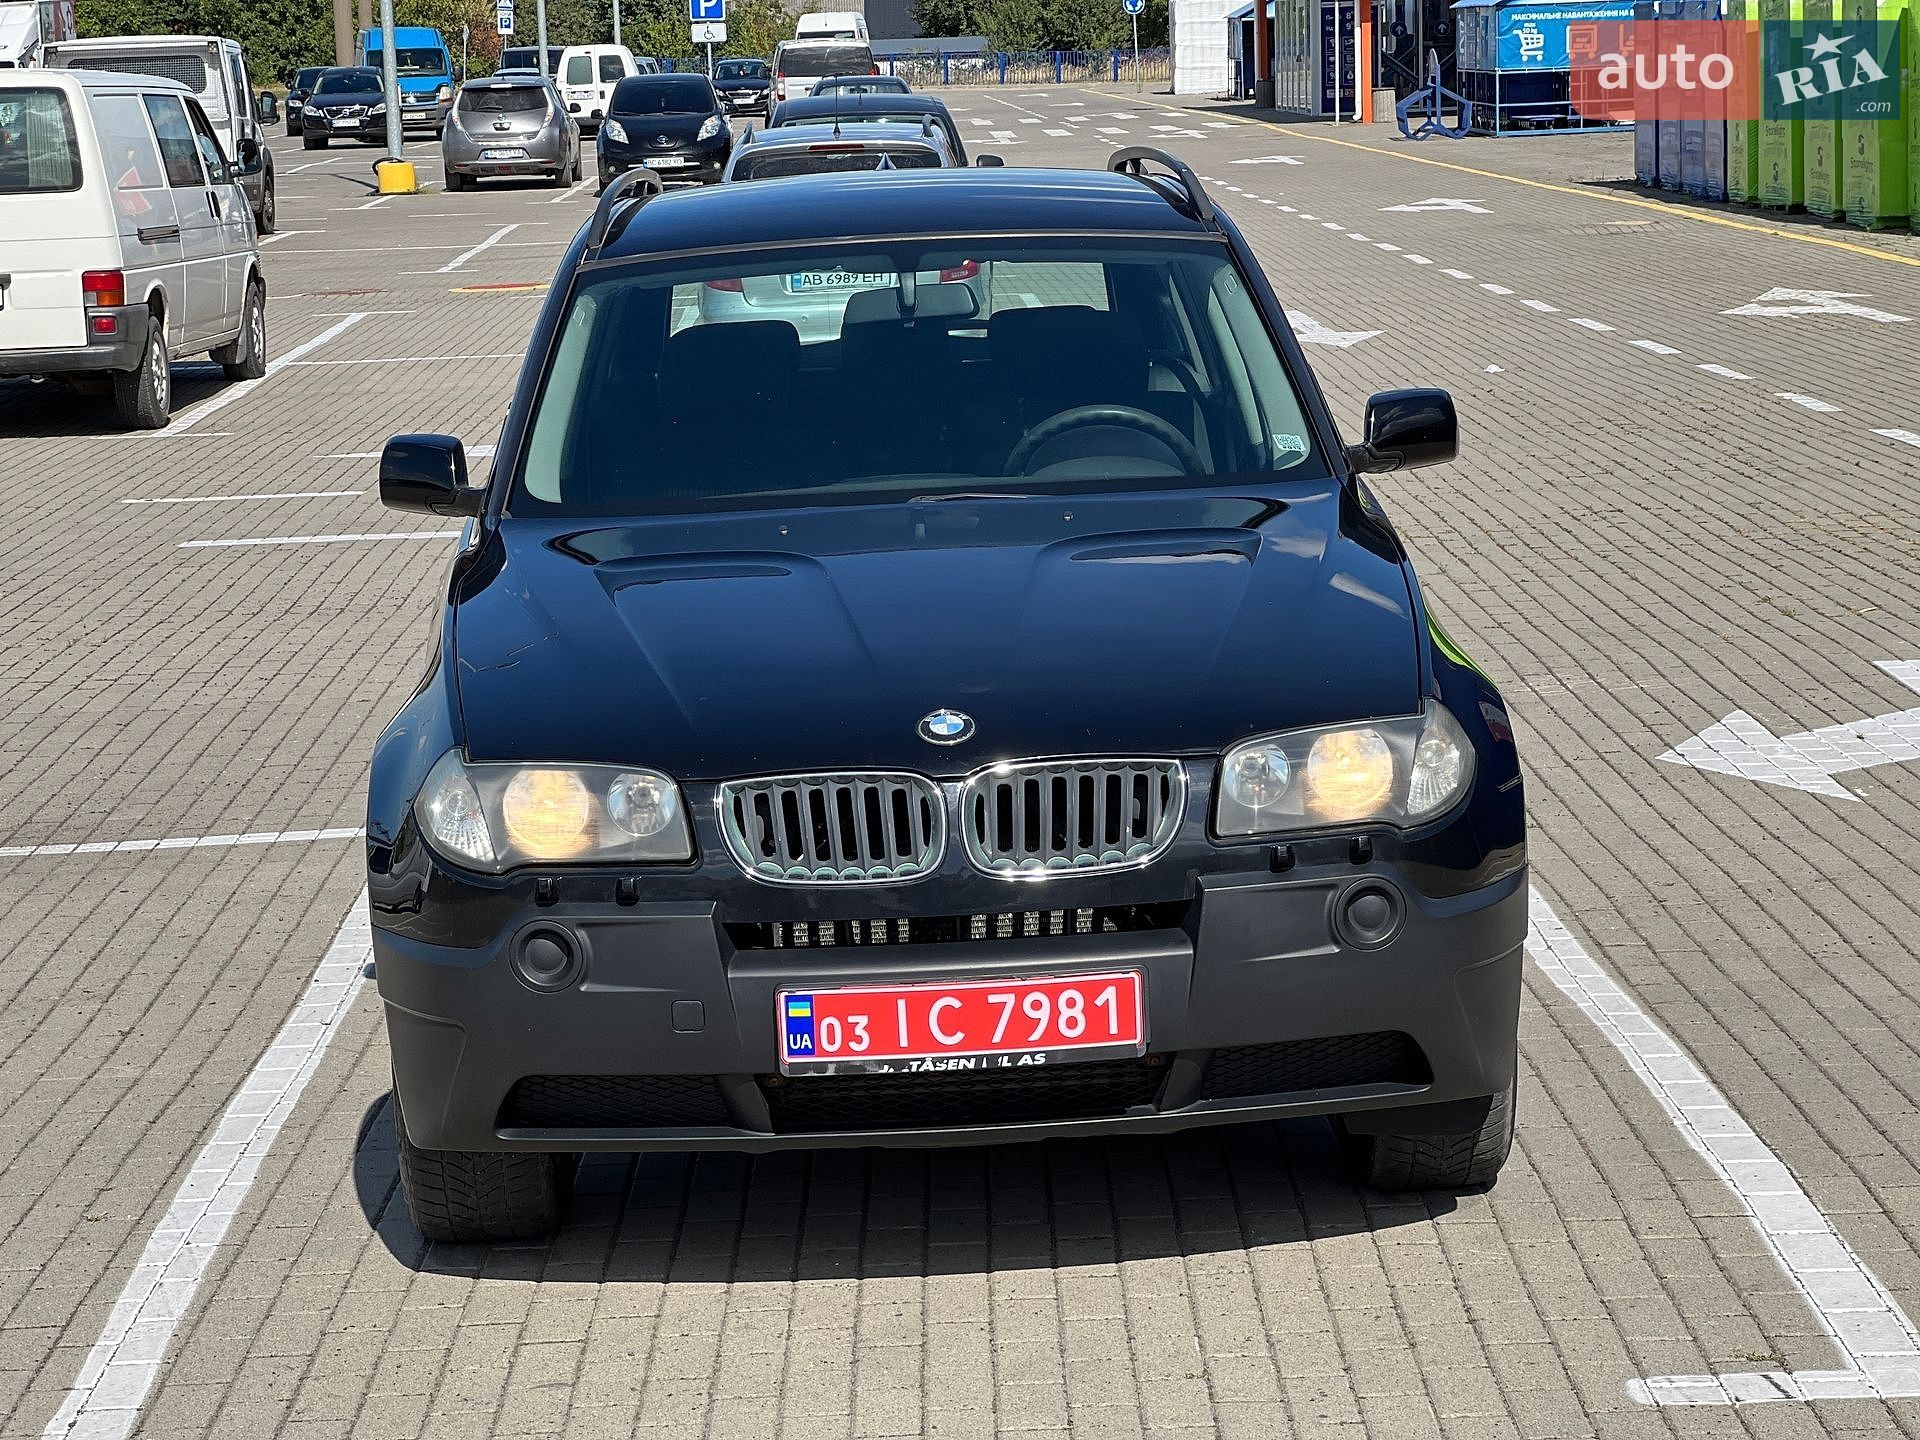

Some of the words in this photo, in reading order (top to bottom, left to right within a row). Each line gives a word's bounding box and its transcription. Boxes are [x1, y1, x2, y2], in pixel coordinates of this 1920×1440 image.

[700, 0, 717, 17] P
[1511, 11, 1561, 21] МАКСИМАЛЬНЕ
[1562, 9, 1618, 19] НАВАНТАЖЕННЯ
[803, 274, 823, 286] AB
[827, 273, 859, 285] 6989
[820, 1014, 871, 1053] 03
[987, 985, 1119, 1044] 7981
[789, 1033, 813, 1050] UA
[1017, 1053, 1047, 1067] AS
